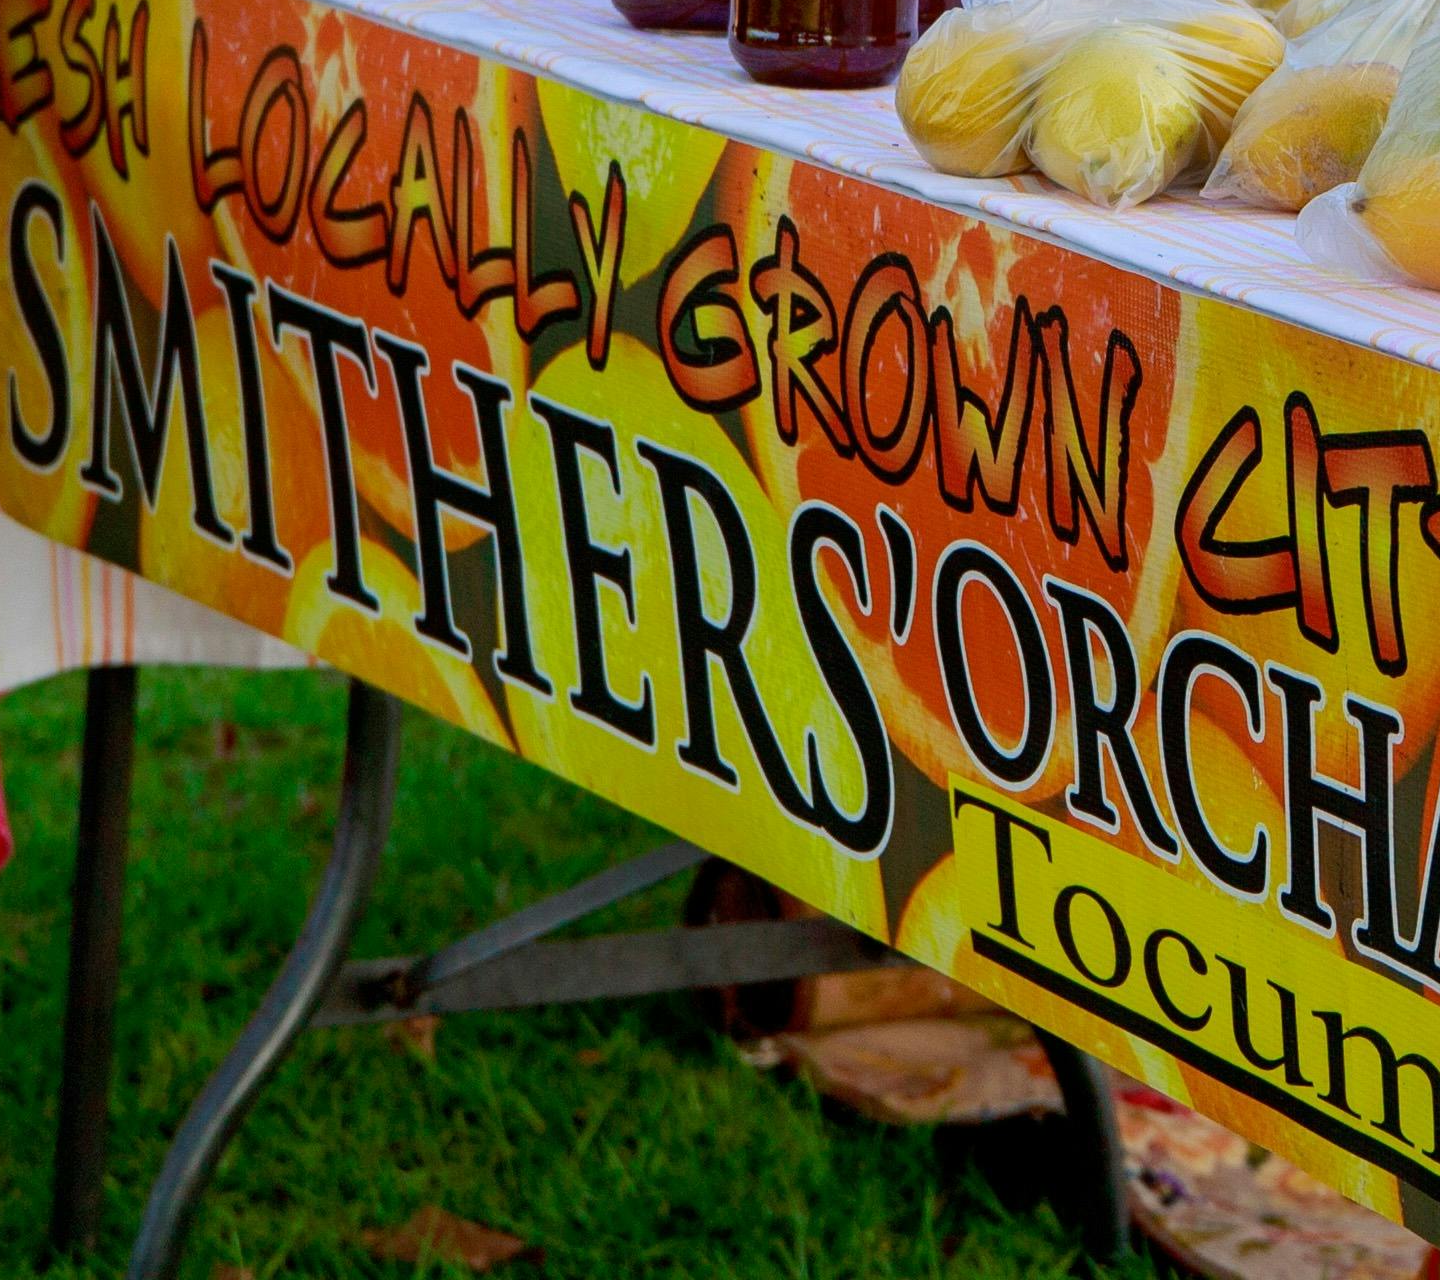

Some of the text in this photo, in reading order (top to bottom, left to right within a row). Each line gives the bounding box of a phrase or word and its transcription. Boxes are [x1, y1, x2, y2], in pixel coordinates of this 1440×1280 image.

[8, 181, 918, 860] SMITHERS'
[188, 16, 627, 372] LOCALLY
[656, 213, 1143, 573] GROWN
